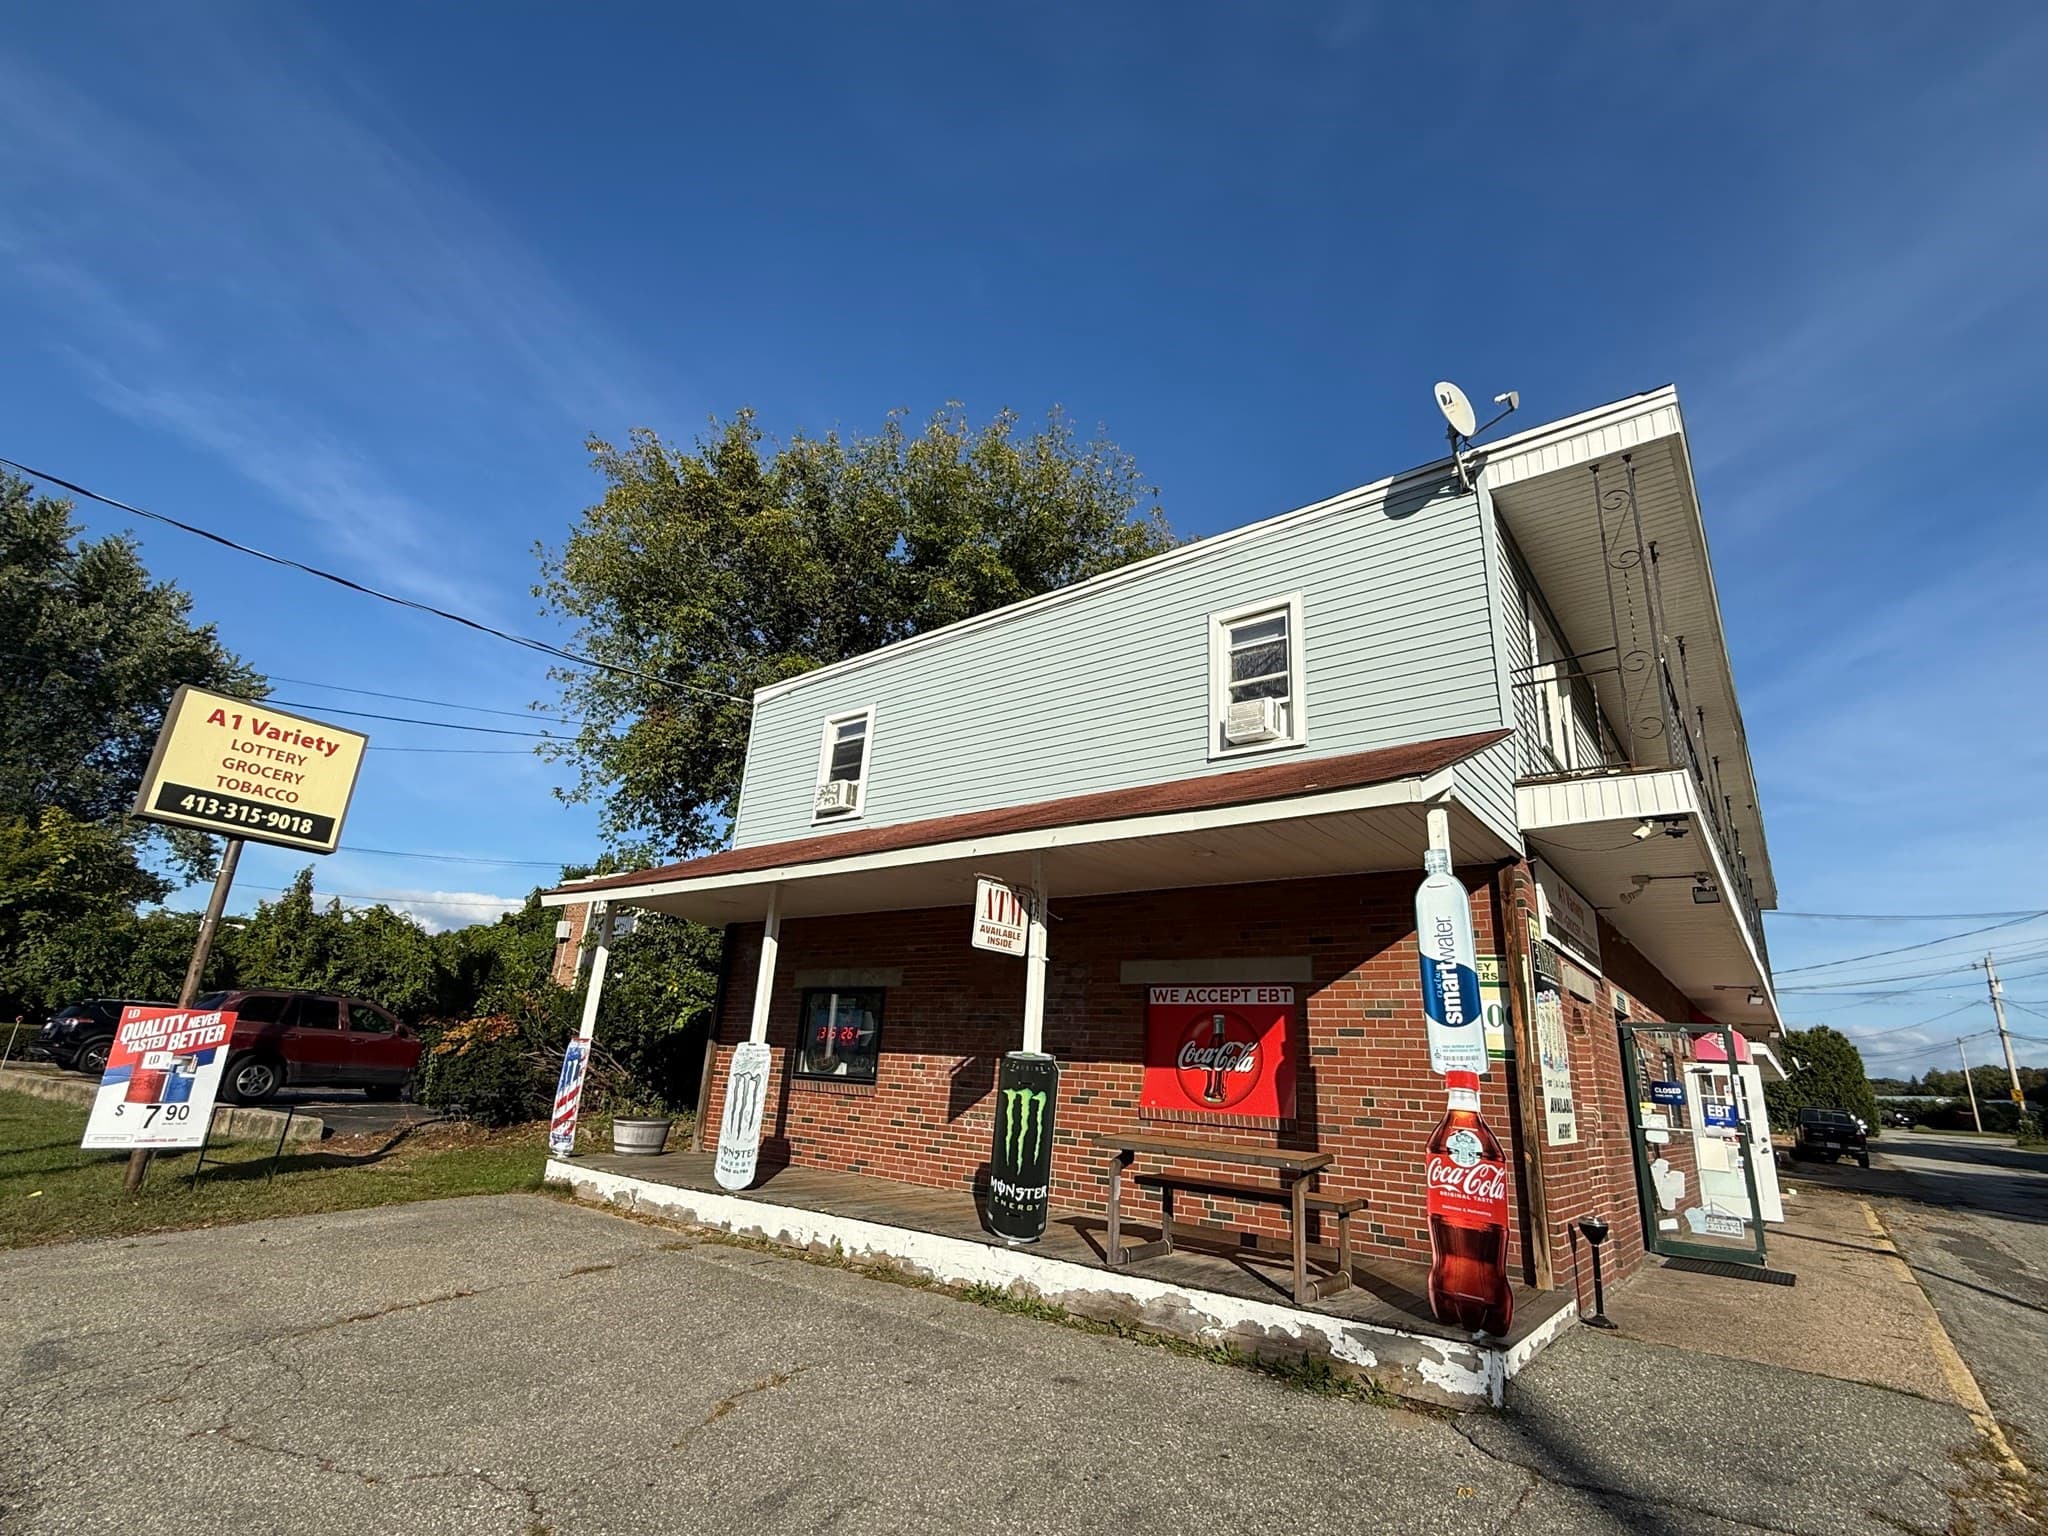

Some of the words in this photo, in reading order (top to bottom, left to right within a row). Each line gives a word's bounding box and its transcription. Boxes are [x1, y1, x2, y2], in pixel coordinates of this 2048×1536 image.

[231, 738, 309, 767] LOTTERY
[251, 718, 341, 758] Variety
[222, 757, 306, 786] GROCERY
[215, 775, 300, 804] TOBACCO
[180, 793, 314, 835] 413-315-9018
[982, 887, 1024, 928] ATM
[980, 924, 1022, 941] AVAILABLE
[987, 935, 1013, 949] INSIDE
[1153, 989, 1179, 1003] WE
[1185, 988, 1253, 1003] ACCEPT
[1257, 988, 1292, 1003] EBT
[119, 1013, 189, 1045] QUALITY
[187, 1012, 222, 1029] NEVER
[126, 1035, 168, 1054] TASTED
[166, 1024, 227, 1051] BETTER
[1178, 1040, 1259, 1073] Coca-Cola
[142, 1105, 162, 1129] 7
[165, 1105, 190, 1121] 90
[1707, 1104, 1731, 1118] EBT
[990, 1175, 1048, 1202] MONSTER
[1427, 1157, 1506, 1200] Coca-Cola
[994, 1196, 1042, 1211] ENERGY
[1439, 1191, 1471, 1200] ORIGINAL
[1473, 1196, 1494, 1204] TASTE
